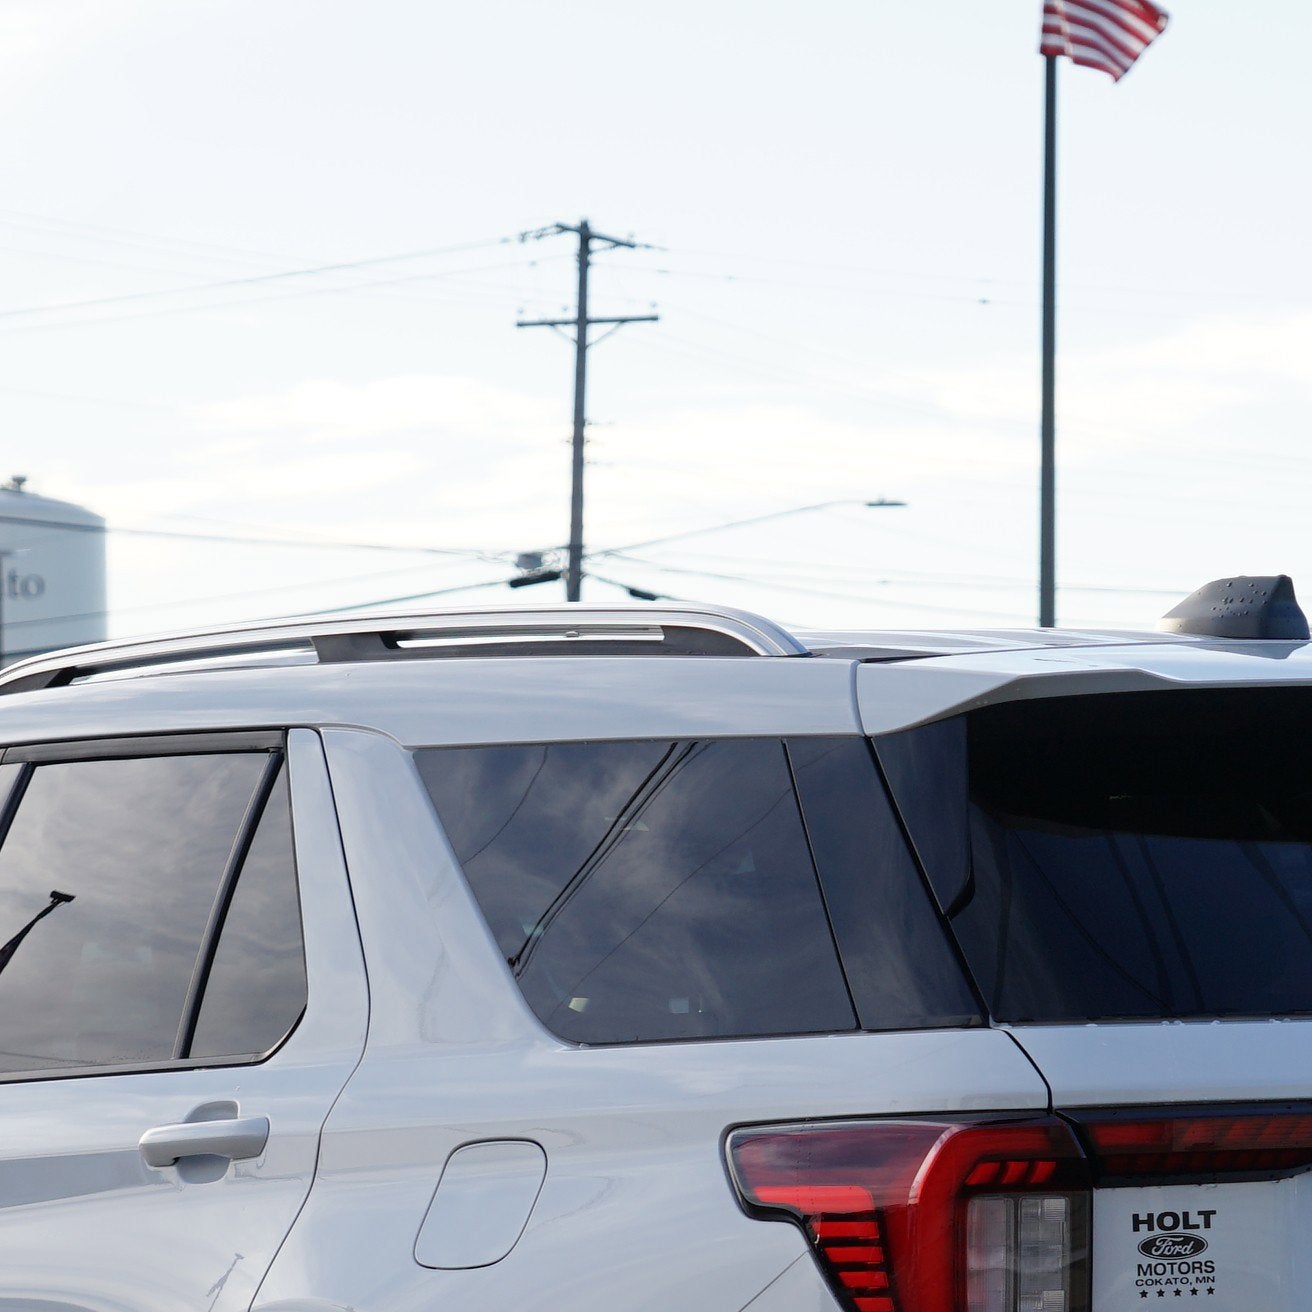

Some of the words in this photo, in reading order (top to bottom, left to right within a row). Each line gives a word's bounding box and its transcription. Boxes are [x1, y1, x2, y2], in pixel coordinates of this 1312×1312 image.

[1132, 1210, 1217, 1232] HOLT
[1151, 1237, 1195, 1256] Ford
[1137, 1260, 1215, 1277] MOTORS
[1135, 1276, 1192, 1287] COKATO,
[1195, 1276, 1216, 1284] MN
